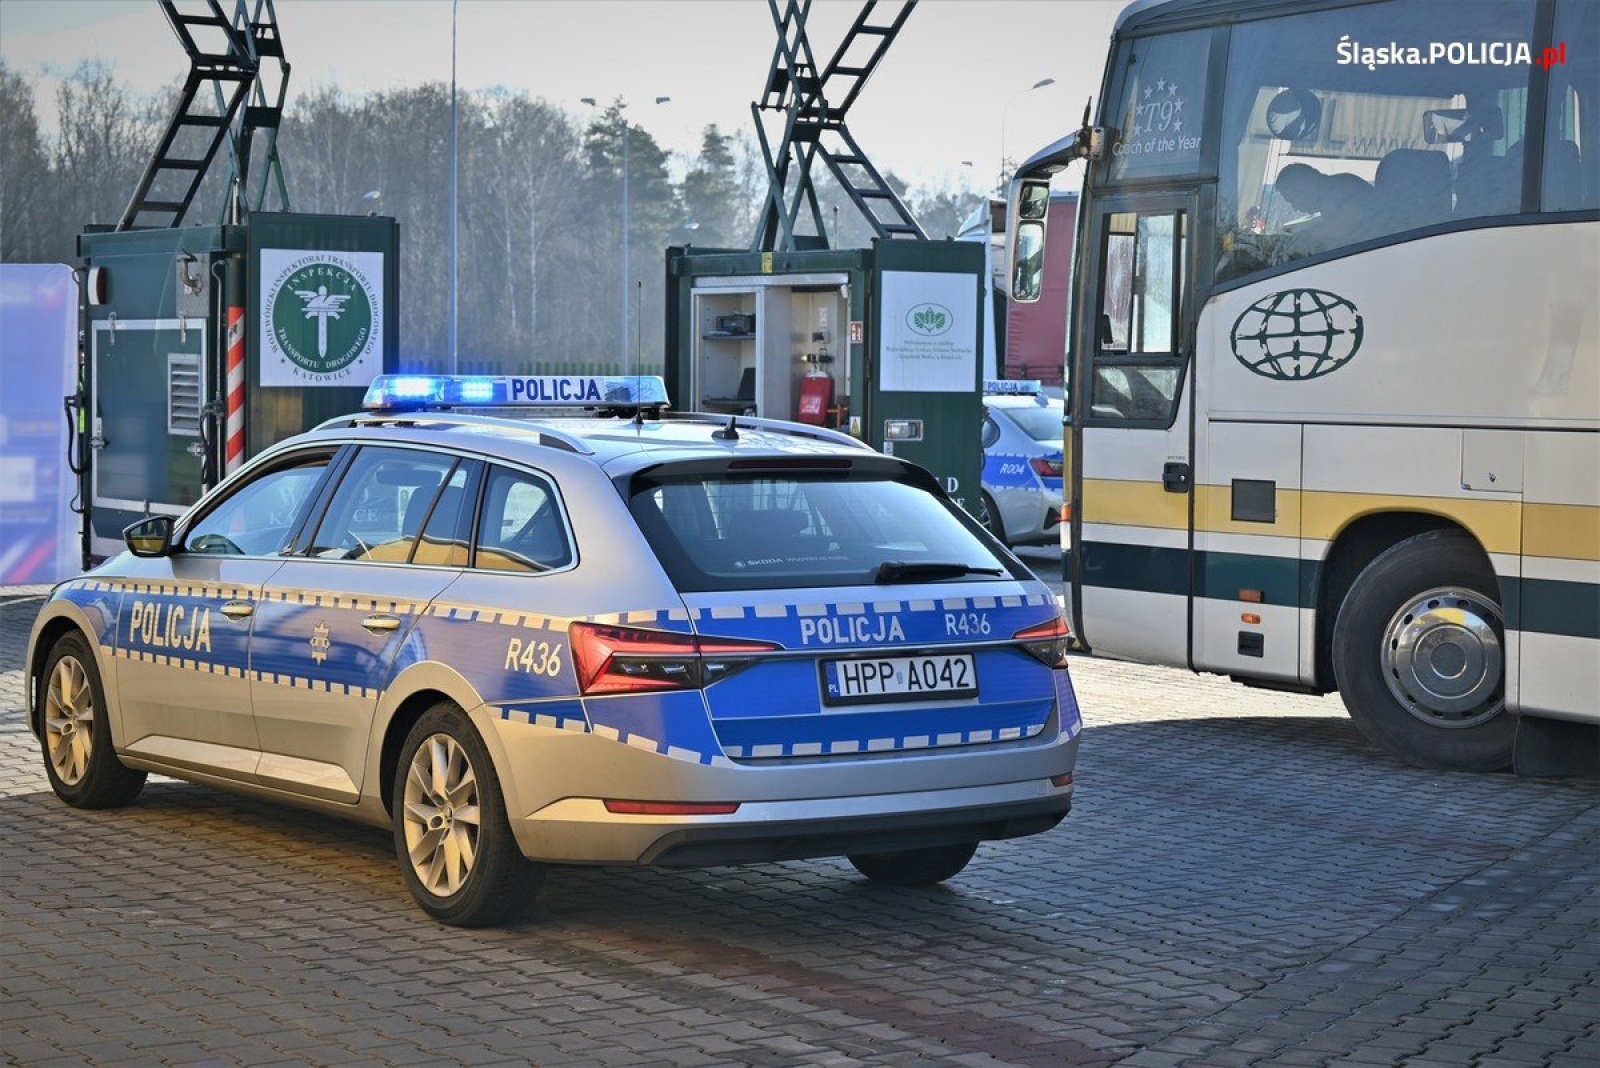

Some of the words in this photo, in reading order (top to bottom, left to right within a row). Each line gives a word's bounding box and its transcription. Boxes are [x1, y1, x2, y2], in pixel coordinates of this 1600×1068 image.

[1144, 101, 1173, 132] T9
[1112, 142, 1142, 156] Coach
[1145, 138, 1156, 152] of
[1158, 137, 1175, 152] the
[1179, 135, 1201, 149] Year
[273, 255, 325, 292] INSPEKTORAT
[287, 267, 356, 291] INSPEKCJA
[278, 327, 320, 369] TRANSPORTU
[325, 327, 367, 369] DROGOWEGO
[292, 366, 352, 382] KATOWICE
[987, 382, 1018, 390] POLICJA
[512, 379, 602, 401] POLICJA
[1000, 463, 1025, 474] R004
[129, 600, 212, 653] POLICJA
[800, 615, 906, 645] POLICJA
[944, 612, 992, 636] R436
[503, 637, 563, 677] R436
[843, 661, 895, 694] HPP
[907, 658, 970, 691] A042
